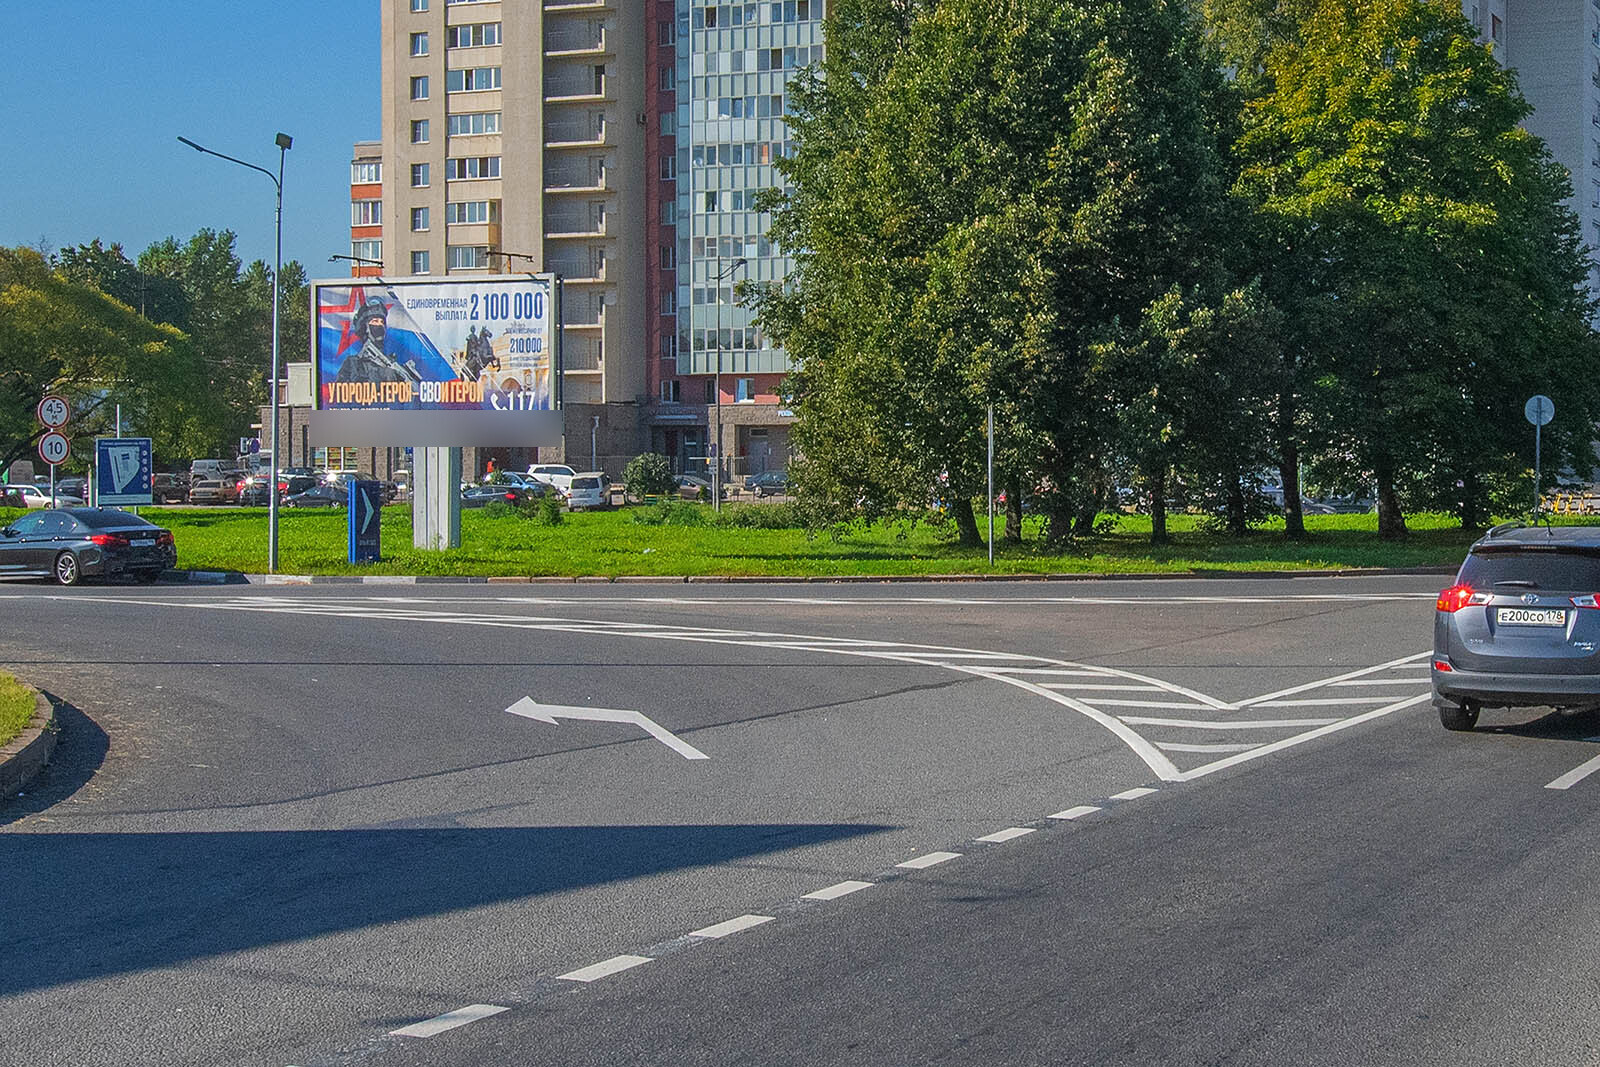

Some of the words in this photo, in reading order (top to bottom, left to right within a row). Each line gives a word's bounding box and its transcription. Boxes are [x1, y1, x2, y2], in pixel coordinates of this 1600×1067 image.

[407, 298, 468, 309] ЕДИНОВРЕМЕННАЯ
[470, 294, 479, 320] 2
[483, 293, 509, 320] 100
[514, 292, 543, 319] 000
[435, 310, 468, 320] ВЫПЛАТА
[510, 338, 525, 353] 210
[526, 337, 542, 353] 000
[328, 382, 335, 403] У
[336, 381, 412, 406] ГОРОДА-ГЕРОЯ
[420, 381, 449, 402] СВОИ
[450, 381, 484, 402] ГЕРОИ
[507, 391, 535, 410] 117
[46, 403, 63, 415] 4,5
[48, 441, 62, 455] 10
